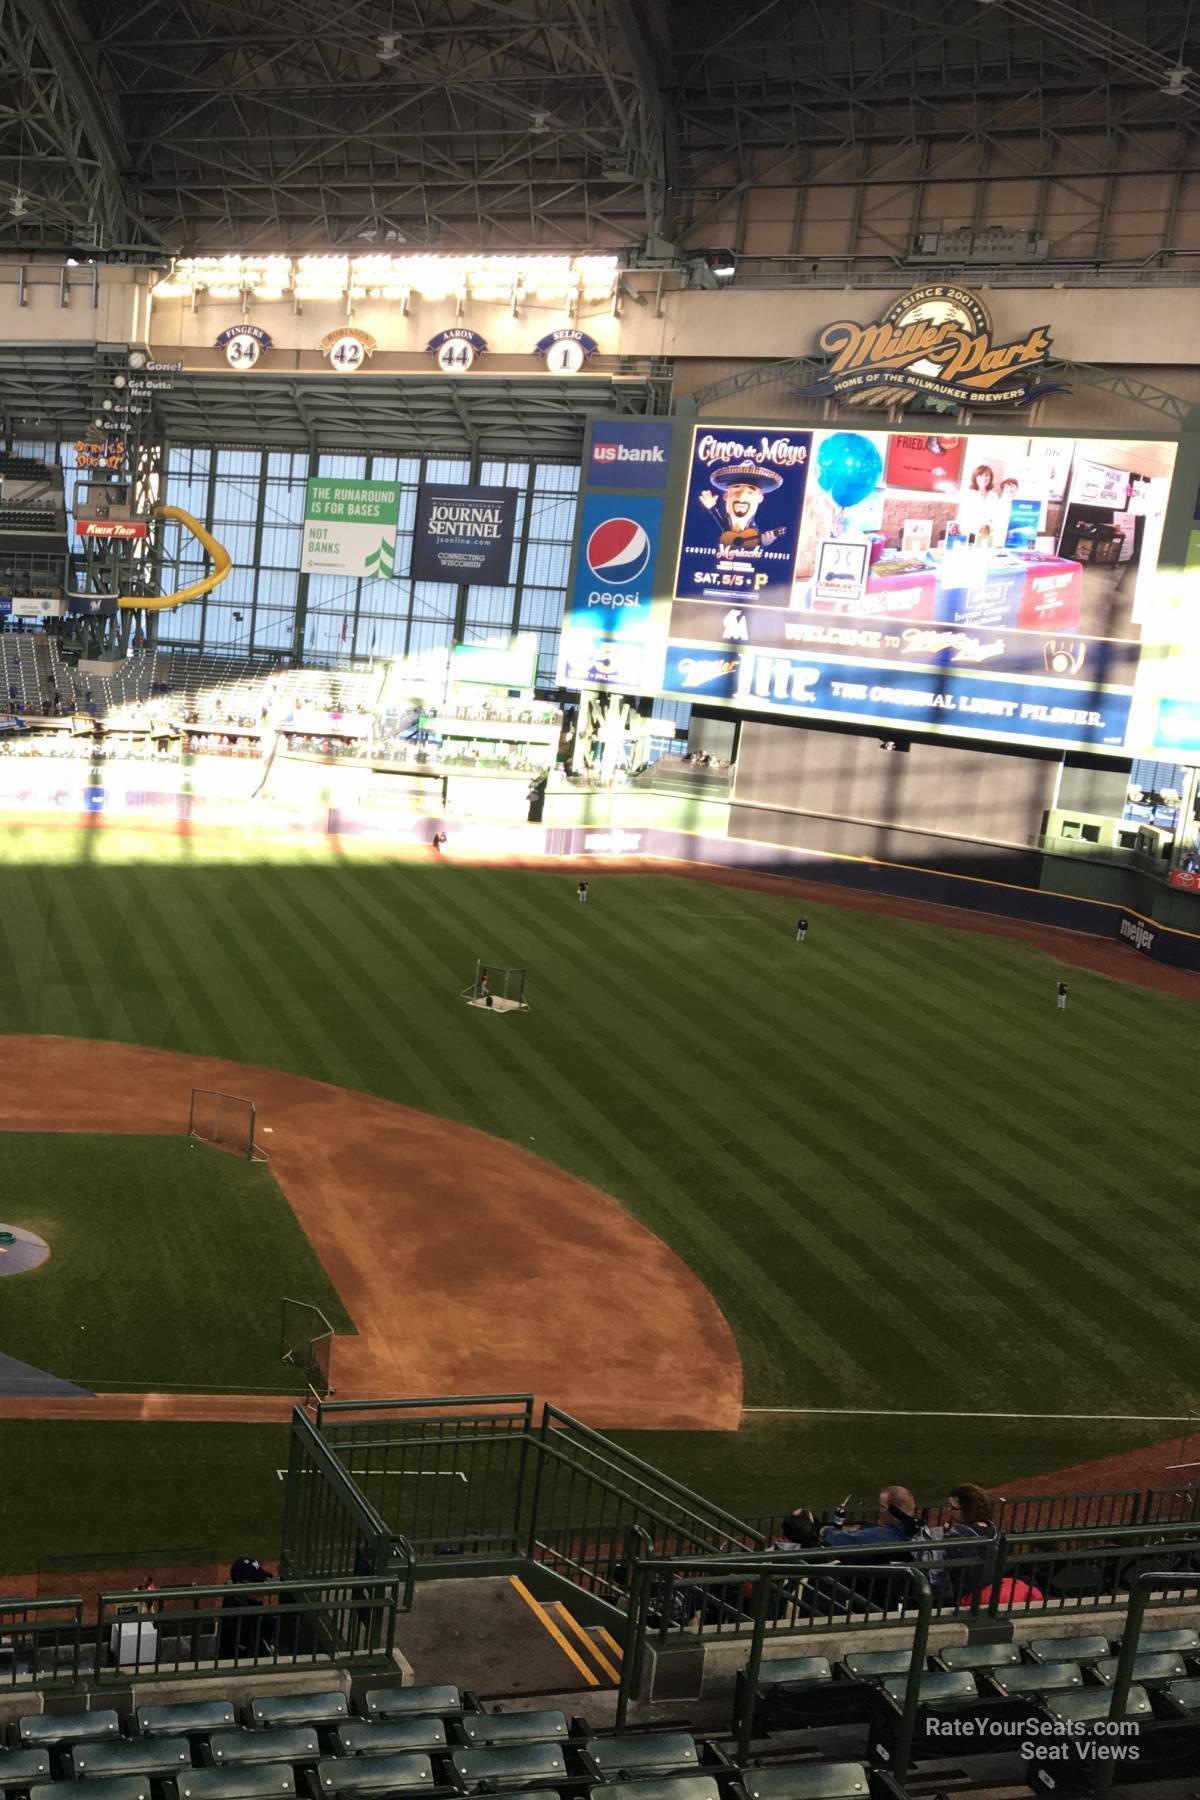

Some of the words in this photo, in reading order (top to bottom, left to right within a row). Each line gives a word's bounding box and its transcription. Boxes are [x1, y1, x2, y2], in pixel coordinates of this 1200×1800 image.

[902, 287, 943, 308] SINCE
[947, 289, 974, 308] 2001
[226, 325, 264, 339] FINGERS
[443, 329, 474, 341] AARON
[553, 330, 582, 341] SELIG
[230, 342, 256, 362] 34
[334, 344, 361, 364] 42
[442, 346, 469, 367] 44
[820, 320, 958, 374] Miller
[927, 328, 1050, 381] Park
[146, 361, 183, 372] Gone!
[559, 349, 570, 370] 1
[128, 380, 144, 390] Get
[131, 389, 152, 397] Here
[834, 376, 864, 392] HOME
[866, 374, 881, 383] OF
[884, 373, 905, 384] THE
[907, 377, 969, 399] MILWAUKEE
[970, 388, 1025, 402] BREWERS
[114, 405, 129, 413] Get
[104, 422, 119, 430] Get
[120, 423, 132, 432] Up
[698, 435, 745, 467] Cinco
[744, 445, 757, 458] de
[756, 437, 808, 466] Mayo
[75, 454, 124, 471] DUGOUT
[313, 487, 332, 500] THE
[334, 488, 395, 504] RUNAROUND
[311, 501, 322, 513] IS
[324, 502, 344, 515] FOR
[347, 503, 380, 517] BASES
[428, 506, 503, 524] JOURNAL
[309, 528, 328, 540] NOT
[427, 521, 502, 538] SENTINEL
[308, 541, 340, 554] BANKS
[436, 537, 491, 546] jsonline.com
[437, 552, 485, 562] CONNECTING
[716, 543, 764, 560] Mariachi
[440, 560, 482, 569] WISCONSIN
[694, 571, 720, 586] SAT,
[722, 574, 745, 587] 5/5
[588, 592, 640, 608] pepsi
[784, 623, 883, 649] WELCOME
[884, 635, 900, 648] TO
[831, 681, 867, 700] THE
[870, 685, 956, 710] ORIGINAL
[959, 694, 1019, 717] LIGHT
[1020, 702, 1106, 728] PILSNER.
[1120, 918, 1155, 950] meijer
